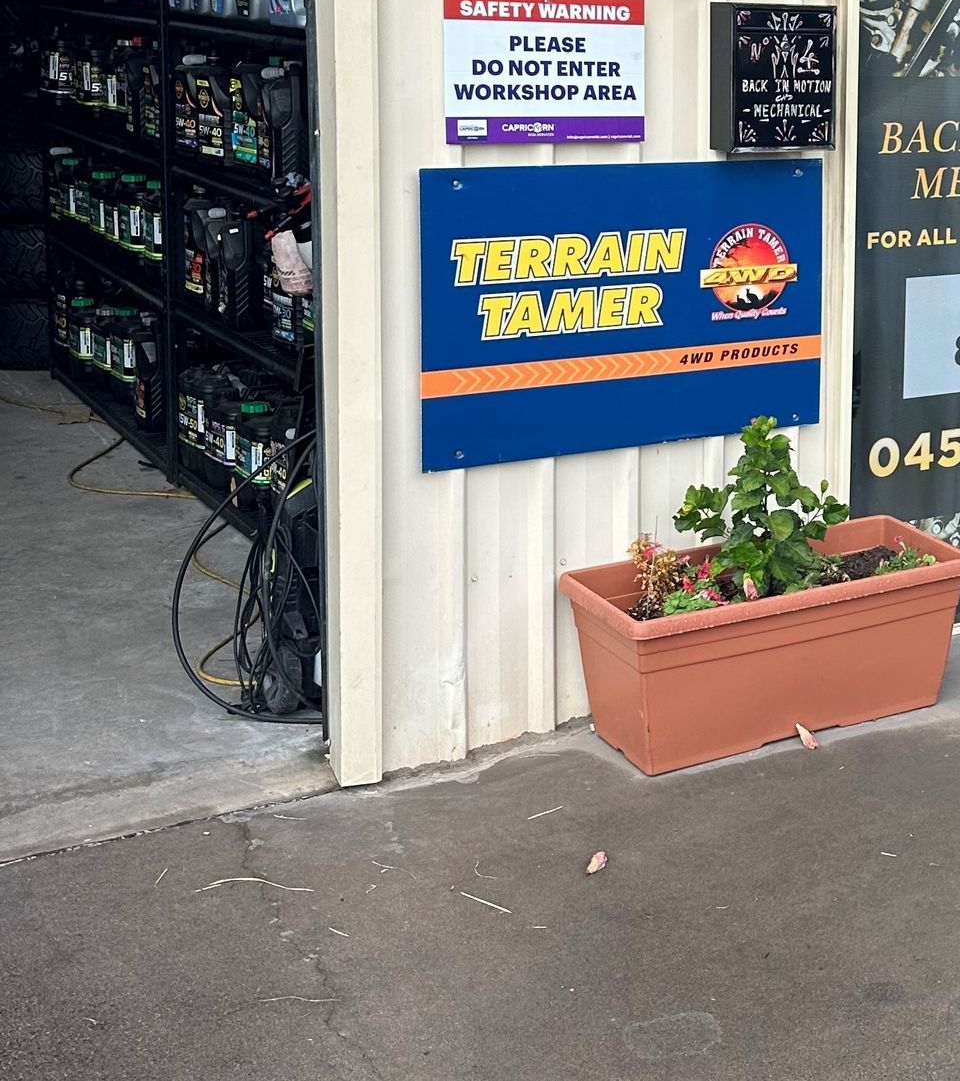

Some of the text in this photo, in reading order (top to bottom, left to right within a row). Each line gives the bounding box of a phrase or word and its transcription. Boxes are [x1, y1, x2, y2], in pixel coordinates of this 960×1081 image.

[460, 0, 630, 21] SAFETY WARNING
[510, 36, 586, 53] PLEASE
[472, 60, 620, 77] DO NOT ENTER
[454, 84, 636, 100] WORKSHOP AREA
[742, 80, 832, 93] BACK IN MOTION
[754, 104, 822, 117] MECHANICAL
[758, 229, 786, 263] TAMER
[867, 228, 911, 250] FOR
[916, 228, 956, 246] ALL
[451, 228, 687, 286] TERRAIN
[704, 266, 796, 285] 4WD
[478, 283, 663, 340] TAMER
[680, 342, 799, 366] 4WD PRODUCTS
